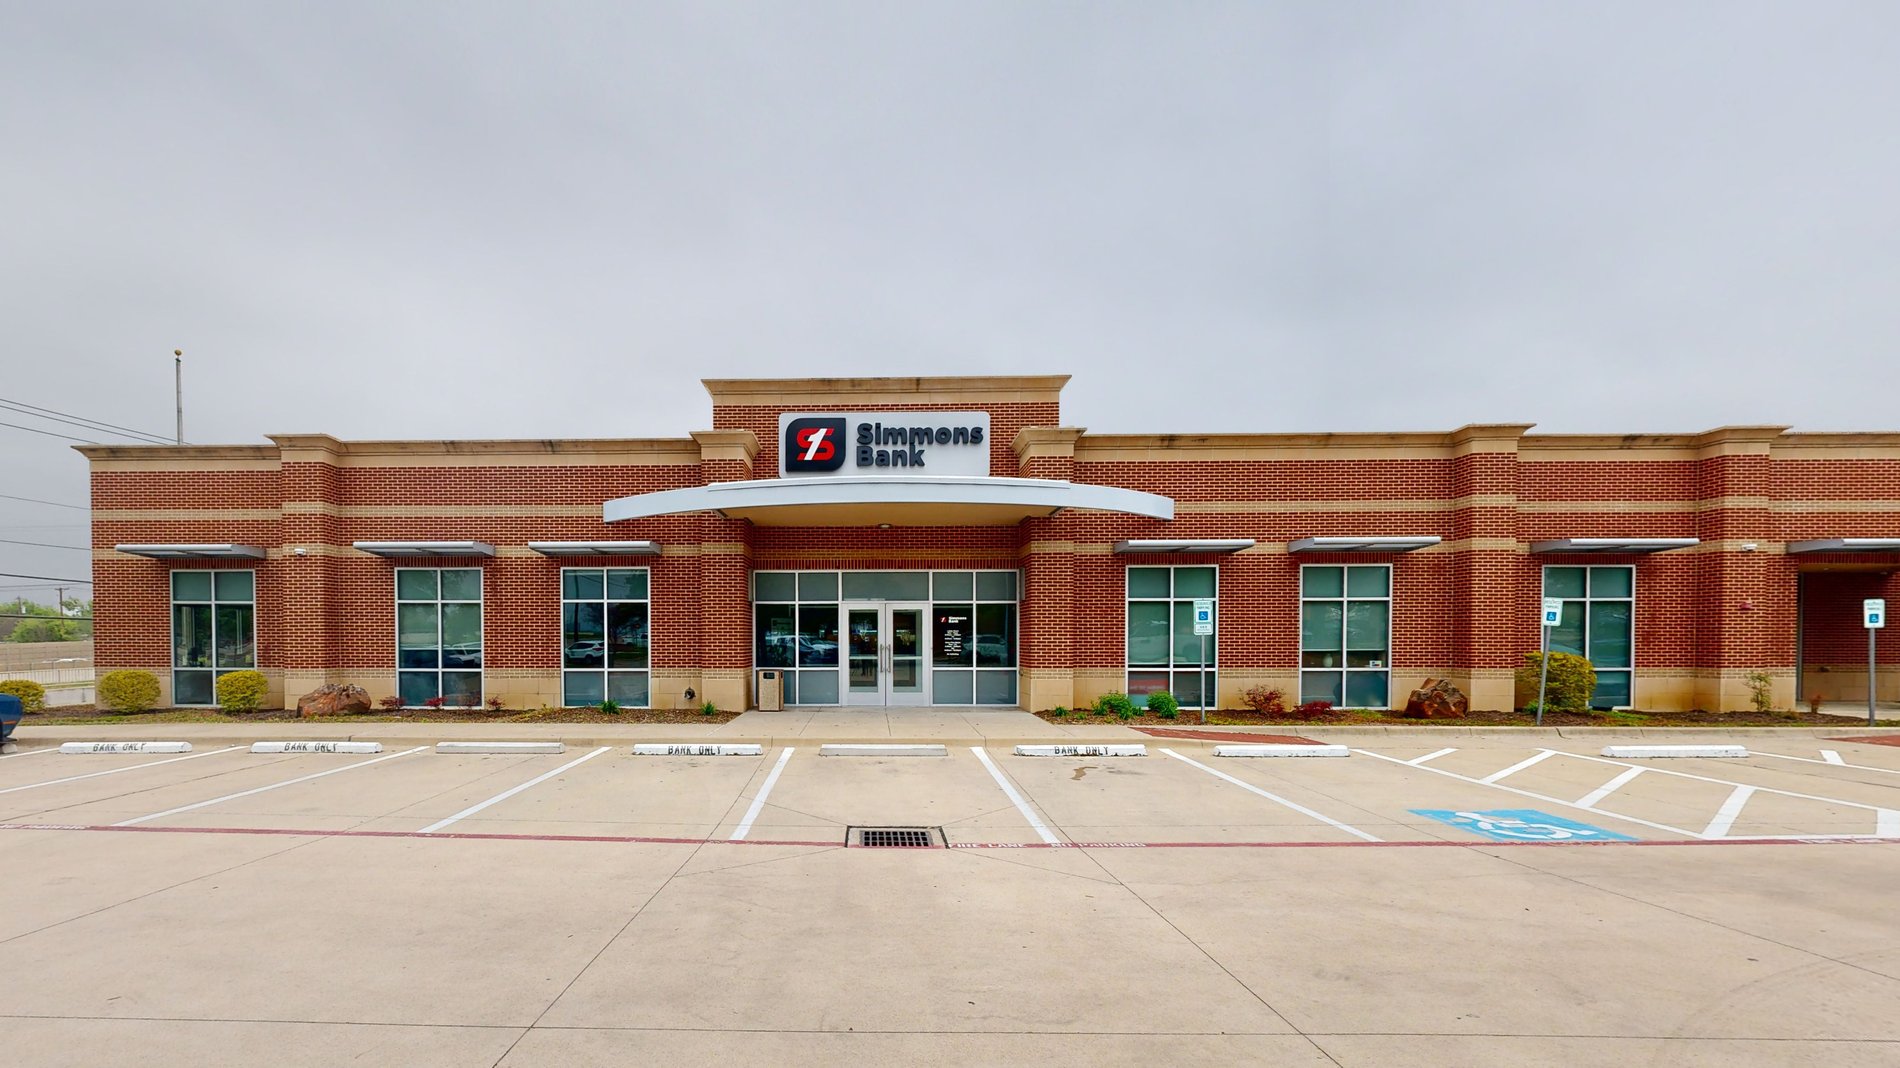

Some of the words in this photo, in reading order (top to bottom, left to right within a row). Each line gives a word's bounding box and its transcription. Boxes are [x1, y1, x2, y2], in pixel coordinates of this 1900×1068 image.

[856, 422, 984, 446] Simmons
[856, 442, 926, 468] Bank
[93, 743, 116, 752] BANK
[122, 742, 146, 751] ONLY
[284, 743, 308, 752] BANK
[314, 743, 338, 752] ONLY
[667, 745, 692, 755] BANK
[698, 745, 722, 755] ONLY
[1054, 746, 1078, 755] BANK
[1085, 746, 1109, 755] ONLY
